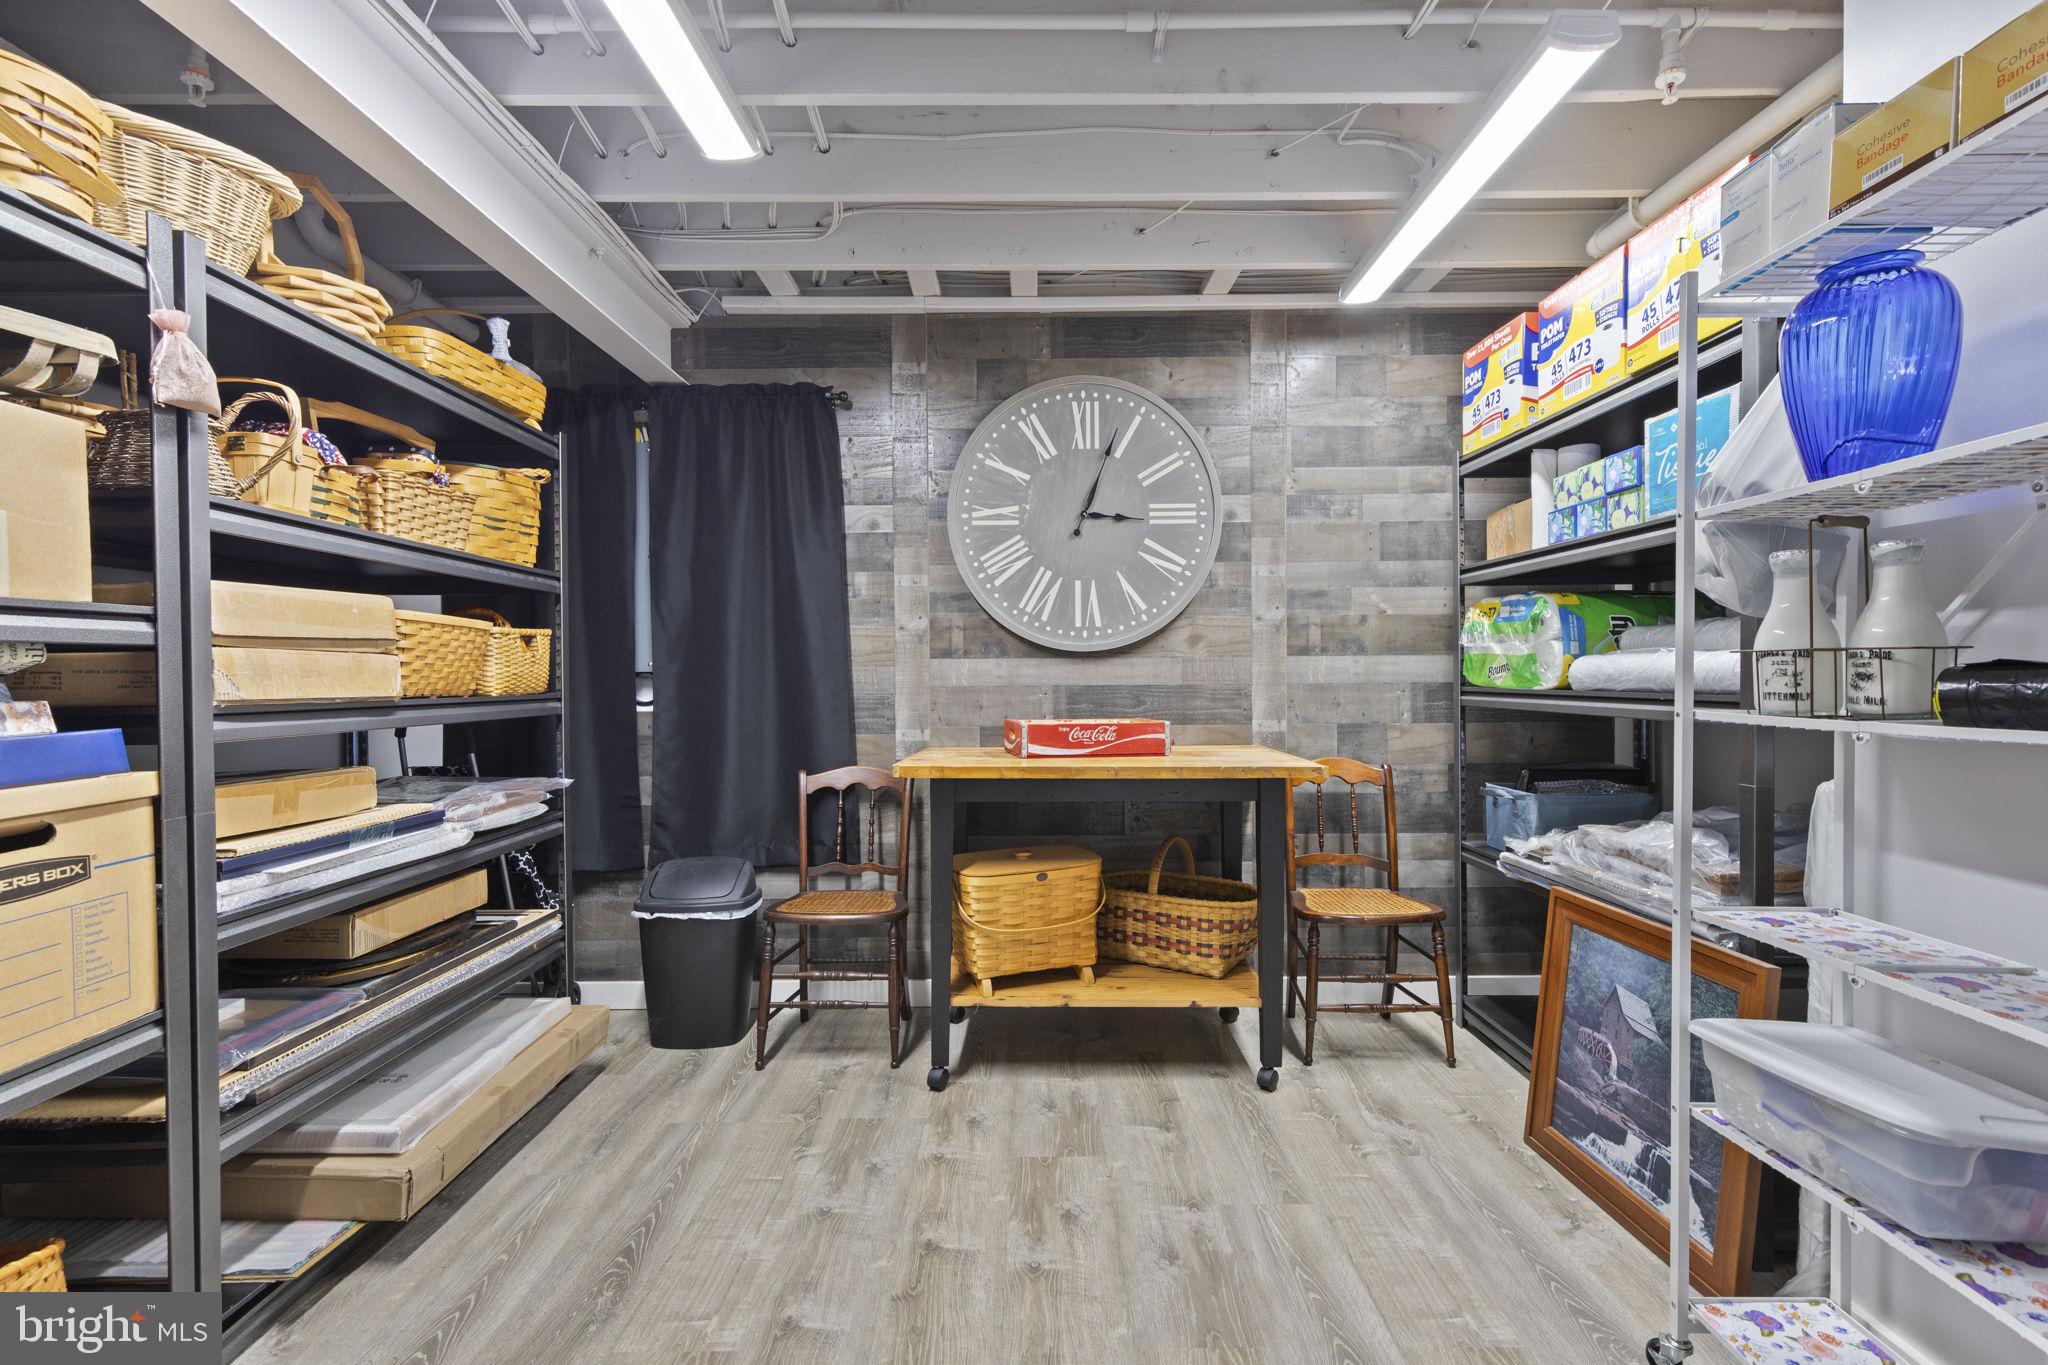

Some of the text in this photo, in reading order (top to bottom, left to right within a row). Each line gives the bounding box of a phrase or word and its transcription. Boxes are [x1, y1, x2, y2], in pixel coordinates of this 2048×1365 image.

[1857, 118, 1911, 157] Cohesive
[1856, 132, 1909, 170] Bandage
[1641, 301, 1658, 324] 45
[1540, 317, 1565, 345] POM
[1641, 315, 1660, 335] ROLLS
[1491, 334, 1513, 352] Per Case
[1568, 338, 1592, 364] 473
[1465, 368, 1482, 390] POM
[1551, 360, 1563, 377] 45
[1551, 372, 1565, 387] ROLLS
[1485, 389, 1501, 410] 473
[1472, 404, 1481, 419] 45
[1071, 400, 1099, 449] XII
[1017, 413, 1058, 464] XI
[984, 453, 1031, 486] X
[1655, 442, 1718, 485] Tiue
[1149, 503, 1197, 525] III
[1116, 570, 1148, 616] V
[1868, 650, 1893, 660] PRDE
[43, 863, 85, 882] BOX
